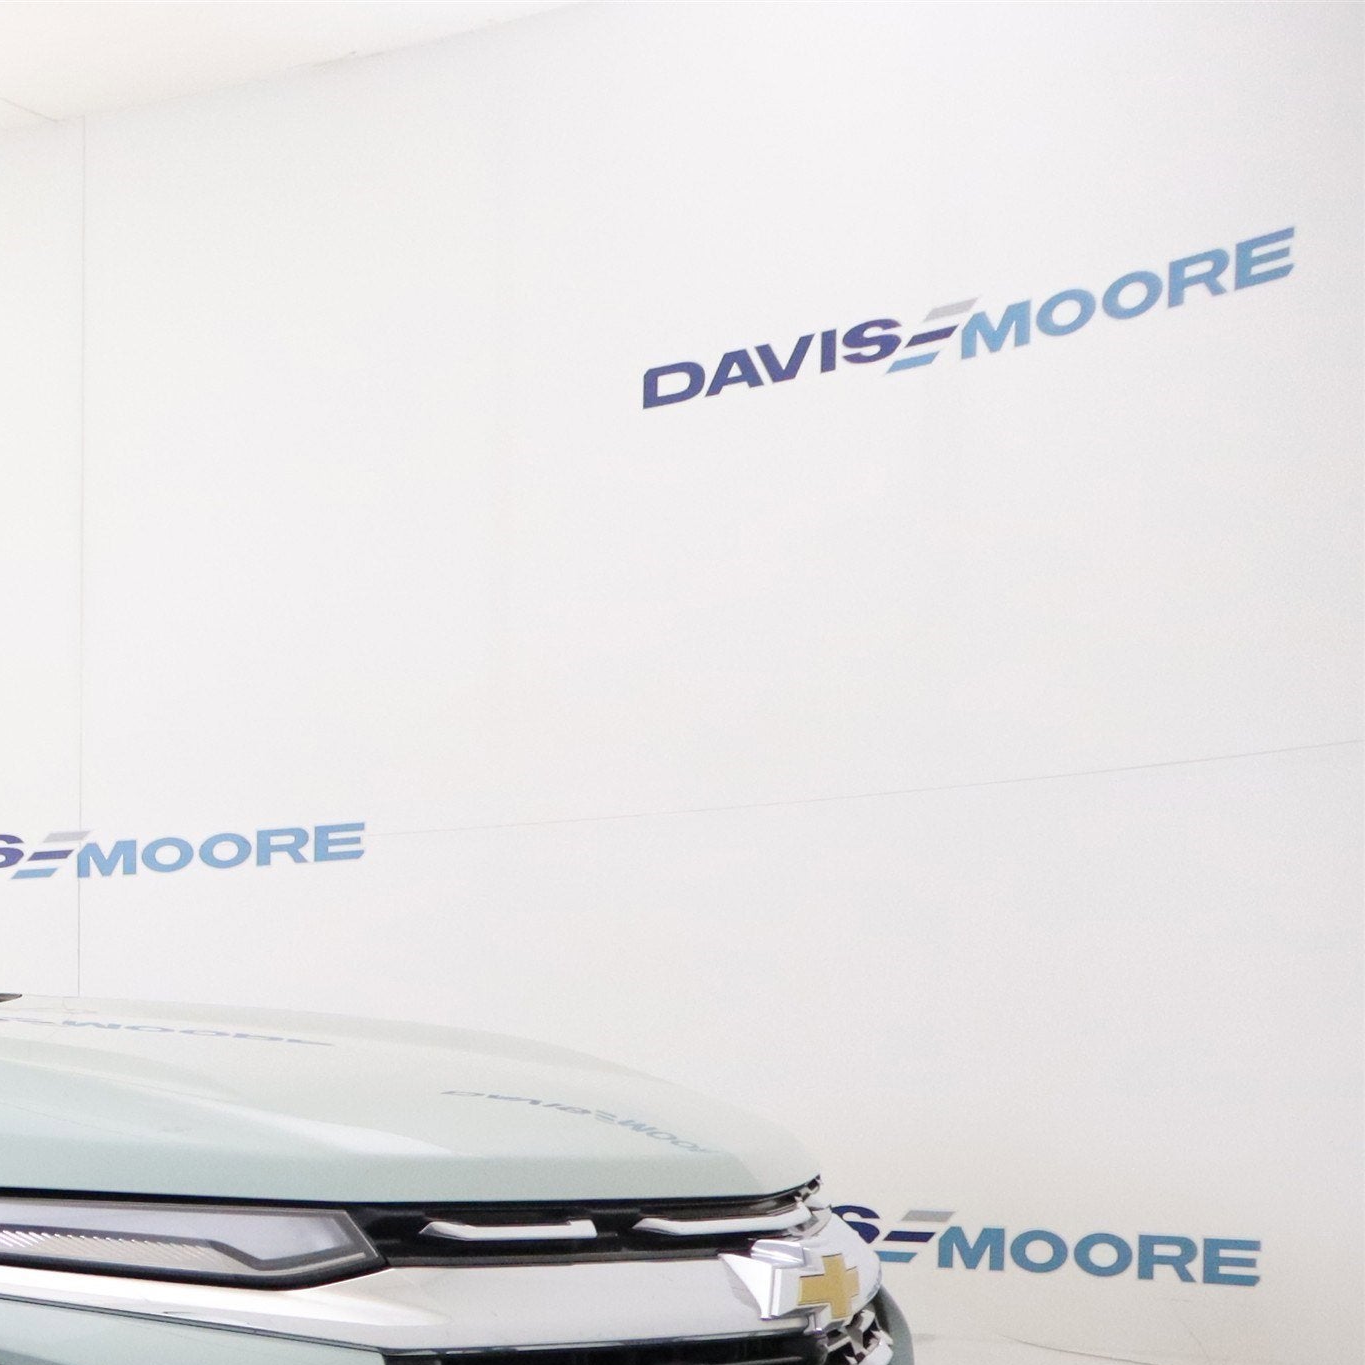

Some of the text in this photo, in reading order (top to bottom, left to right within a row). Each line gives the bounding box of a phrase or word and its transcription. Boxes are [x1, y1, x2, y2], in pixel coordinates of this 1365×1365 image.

[642, 226, 1296, 410] DAVIS MOORE
[77, 822, 366, 879] MOORE
[937, 1225, 1262, 1286] MOORE
